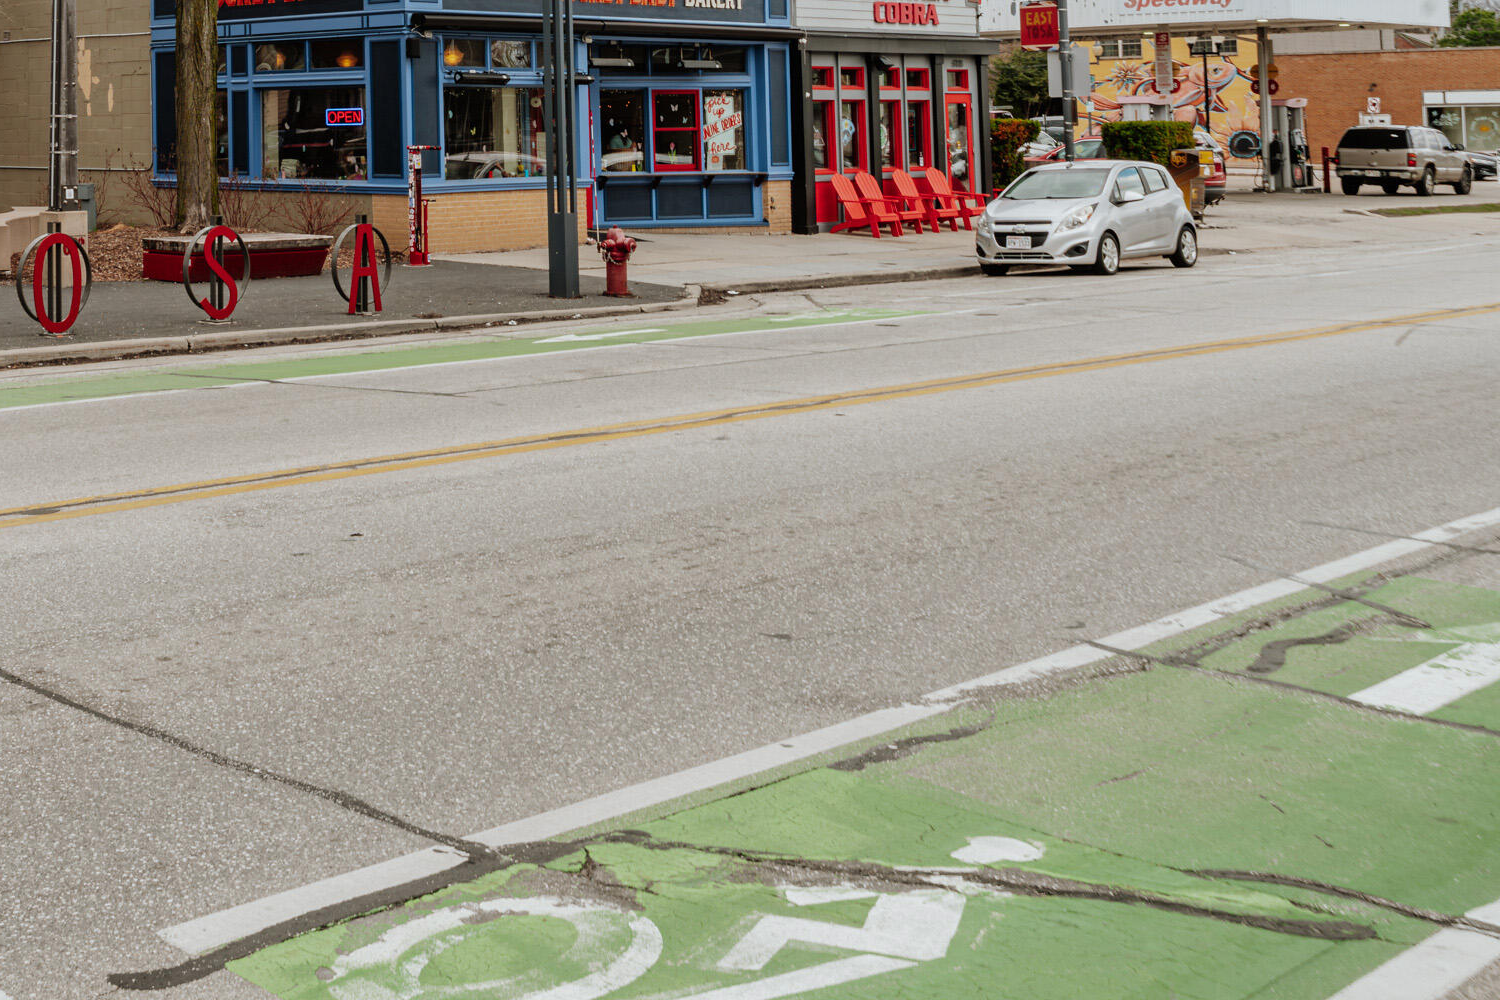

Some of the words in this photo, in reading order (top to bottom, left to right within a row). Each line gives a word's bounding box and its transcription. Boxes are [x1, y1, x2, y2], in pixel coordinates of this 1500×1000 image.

[873, 1, 939, 26] COBRA
[1026, 11, 1052, 26] EAST
[1027, 25, 1053, 39] TOSA
[705, 95, 730, 113] pick
[327, 110, 361, 124] OPEN
[713, 107, 725, 118] up
[720, 113, 741, 131] ORDERS
[708, 141, 736, 155] here
[33, 232, 82, 333] O
[199, 225, 238, 320] S
[348, 223, 382, 314] A
